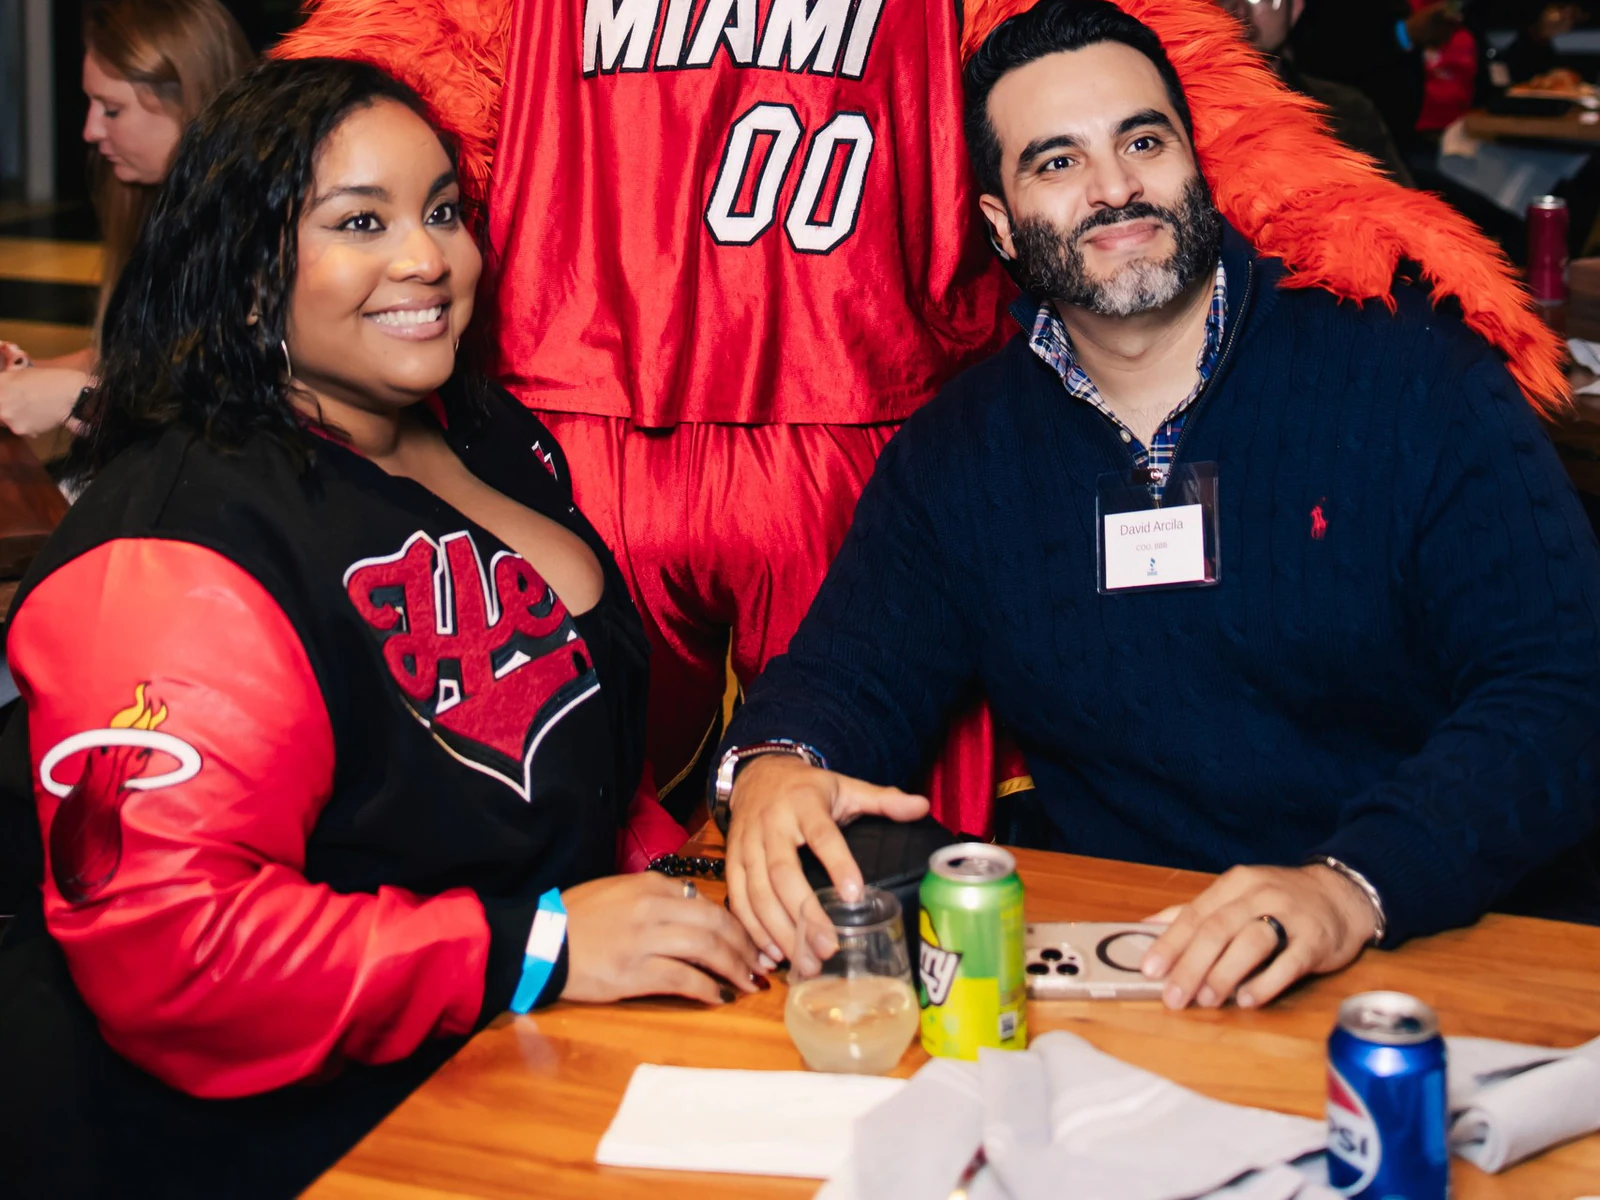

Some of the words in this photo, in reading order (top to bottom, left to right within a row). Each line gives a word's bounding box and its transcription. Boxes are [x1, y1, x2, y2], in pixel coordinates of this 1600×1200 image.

[704, 101, 875, 256] 00
[1120, 521, 1151, 536] David
[1153, 518, 1184, 532] Arcila
